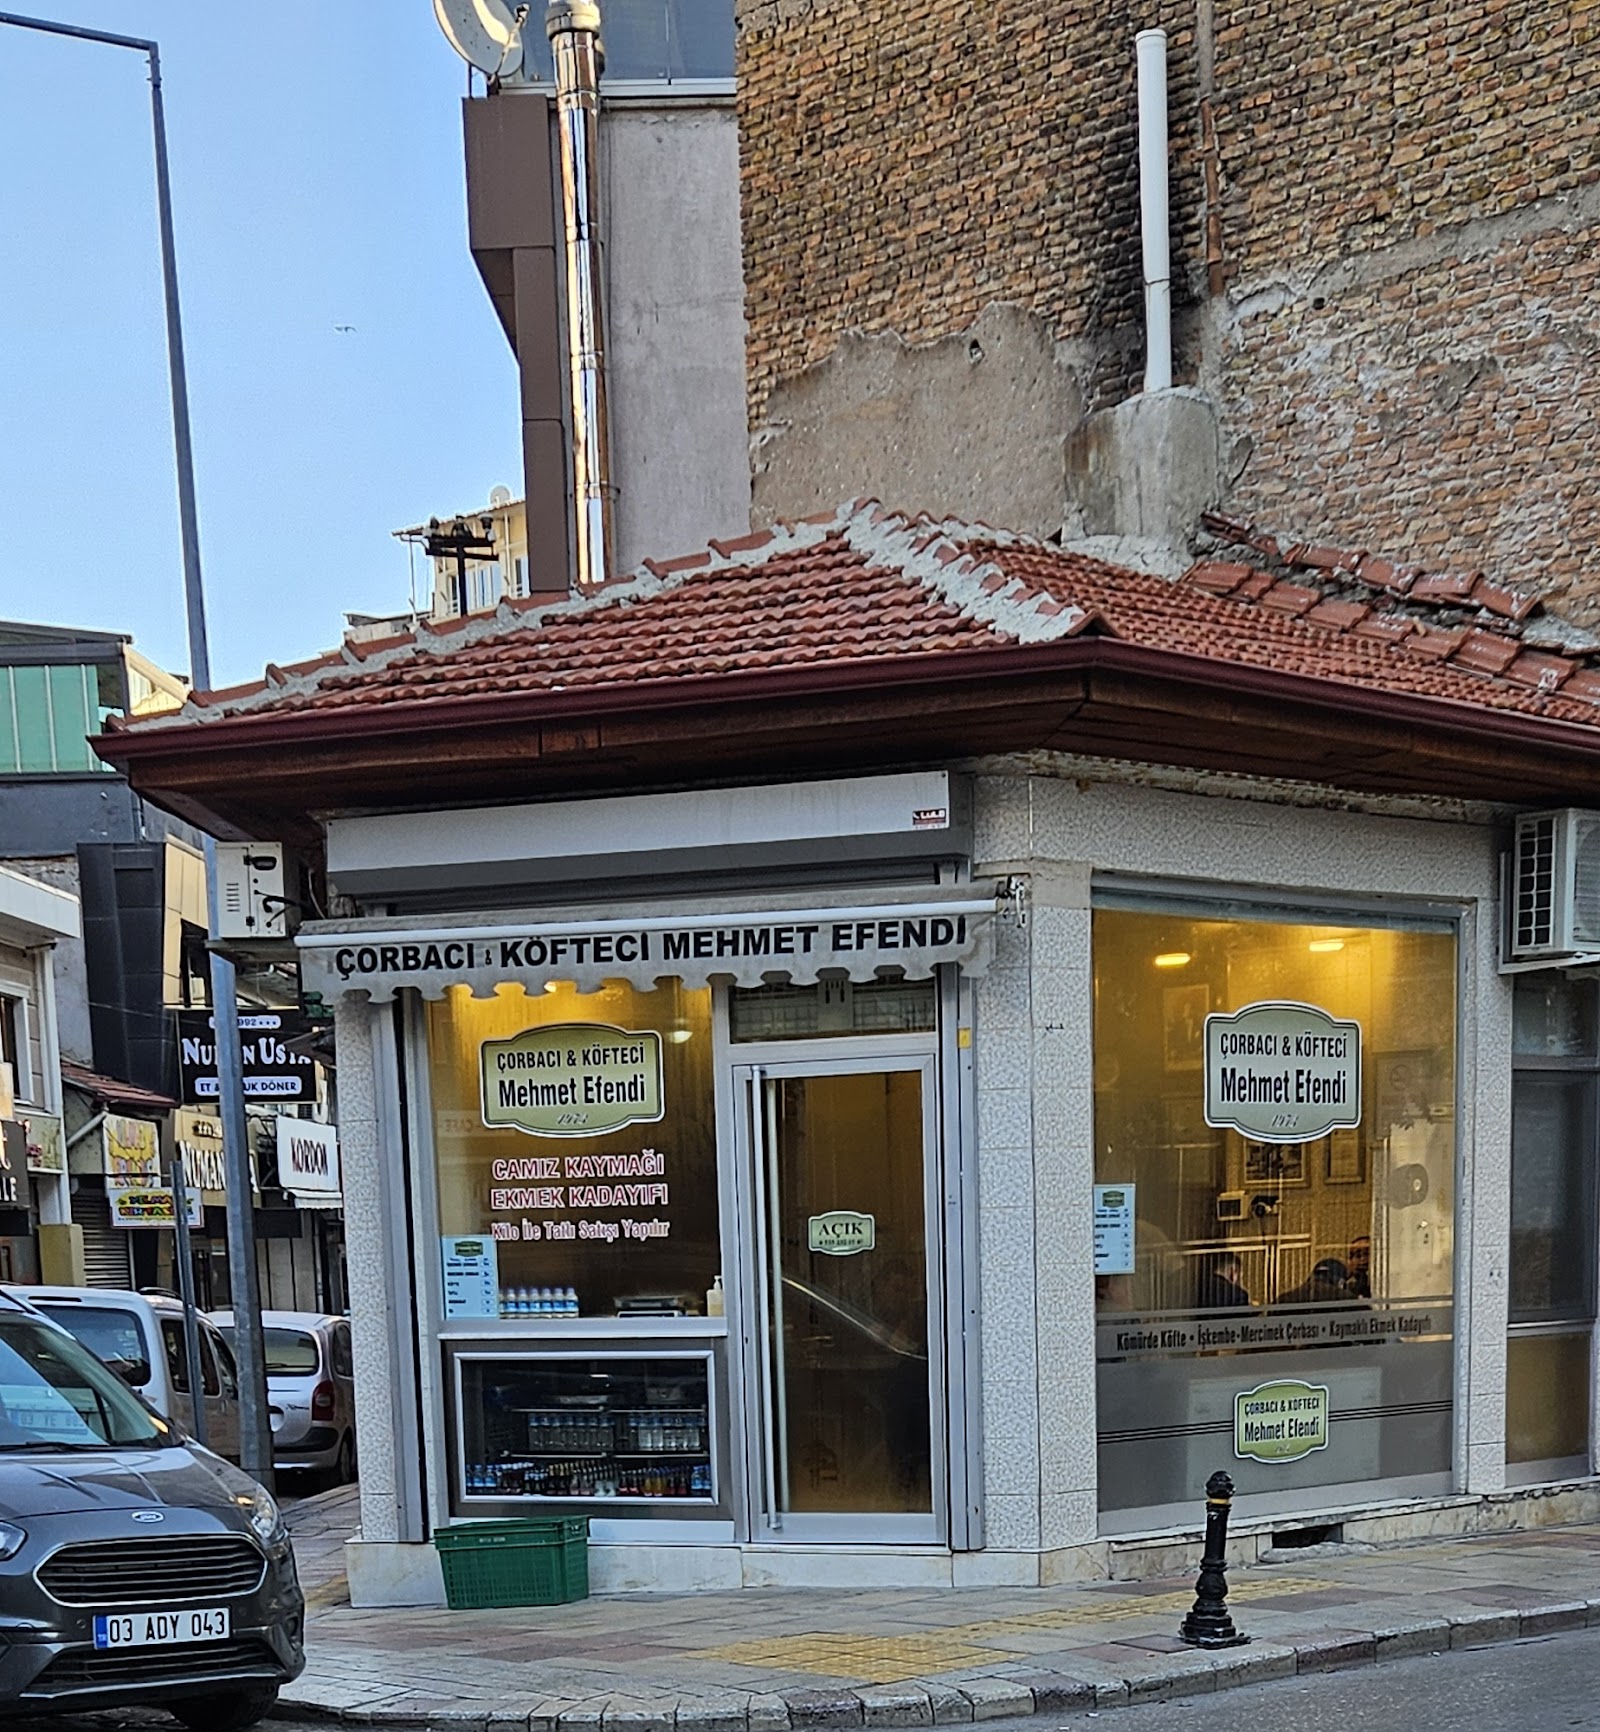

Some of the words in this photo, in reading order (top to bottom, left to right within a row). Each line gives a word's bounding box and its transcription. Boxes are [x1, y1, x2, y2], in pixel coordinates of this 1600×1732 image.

[336, 943, 474, 980] ÇORBACI
[500, 932, 650, 968] KÖFTECİ
[663, 925, 819, 960] MEHMET
[832, 914, 966, 951] EFENDİ
[181, 1037, 256, 1065] NUN
[497, 1050, 561, 1072] ÇORBACI
[567, 1050, 577, 1067] &
[582, 1042, 645, 1067] KÖFTECİ
[1220, 1033, 1277, 1059] ÇORBACI
[1282, 1035, 1291, 1056] &
[1295, 1031, 1347, 1058] KÖFTECİ
[200, 1083, 211, 1092] ET
[261, 1080, 297, 1091] DÖNER
[499, 1076, 577, 1108] Mehmet
[583, 1074, 645, 1104] Efendi
[1221, 1067, 1289, 1103] Mehmet
[1295, 1069, 1347, 1104] Efendi
[491, 1157, 561, 1181] CAMIZ
[565, 1149, 665, 1179] KAYMAĞI
[490, 1187, 566, 1210] EKMEK
[568, 1183, 669, 1208] KADAYIFI
[491, 1221, 520, 1241] Kilo
[543, 1220, 577, 1240] Tatlı
[578, 1219, 620, 1243] Satışı
[620, 1218, 671, 1242] Yapılır
[818, 1222, 864, 1239] AÇIK
[1160, 1329, 1187, 1349] Köfte
[1244, 1400, 1279, 1417] ÇORBACI
[1280, 1399, 1286, 1412] &
[1244, 1420, 1285, 1442] Mehmet
[1288, 1416, 1320, 1438] Efendi
[109, 1619, 133, 1643] 03
[146, 1615, 179, 1641] ADY
[191, 1612, 225, 1637] 043
